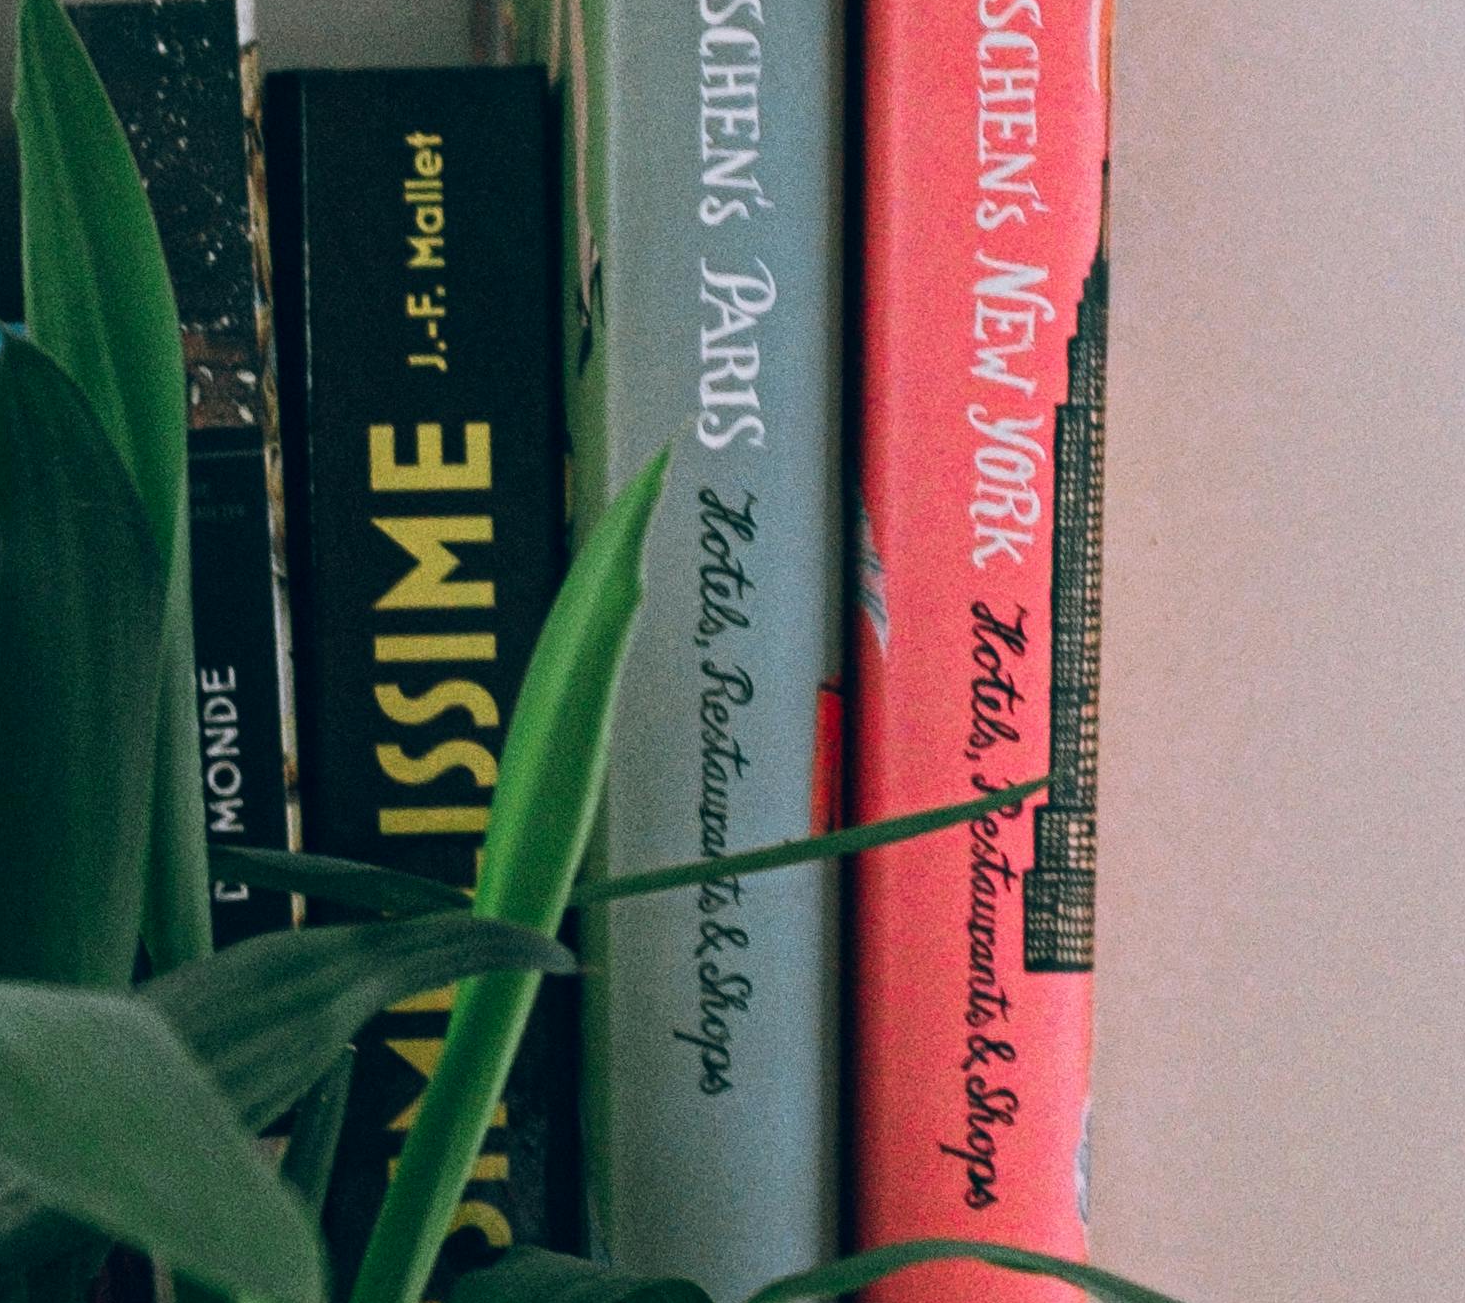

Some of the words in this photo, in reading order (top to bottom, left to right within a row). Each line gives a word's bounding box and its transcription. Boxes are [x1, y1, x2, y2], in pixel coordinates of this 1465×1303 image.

[405, 130, 446, 271] Mallet
[408, 286, 448, 372] J.-F.
[697, 256, 777, 450] PARIS
[201, 666, 246, 833] MONDE
[698, 655, 754, 914] Restaurats
[673, 962, 754, 1097] Shops
[938, 1072, 1021, 1212] Shops
